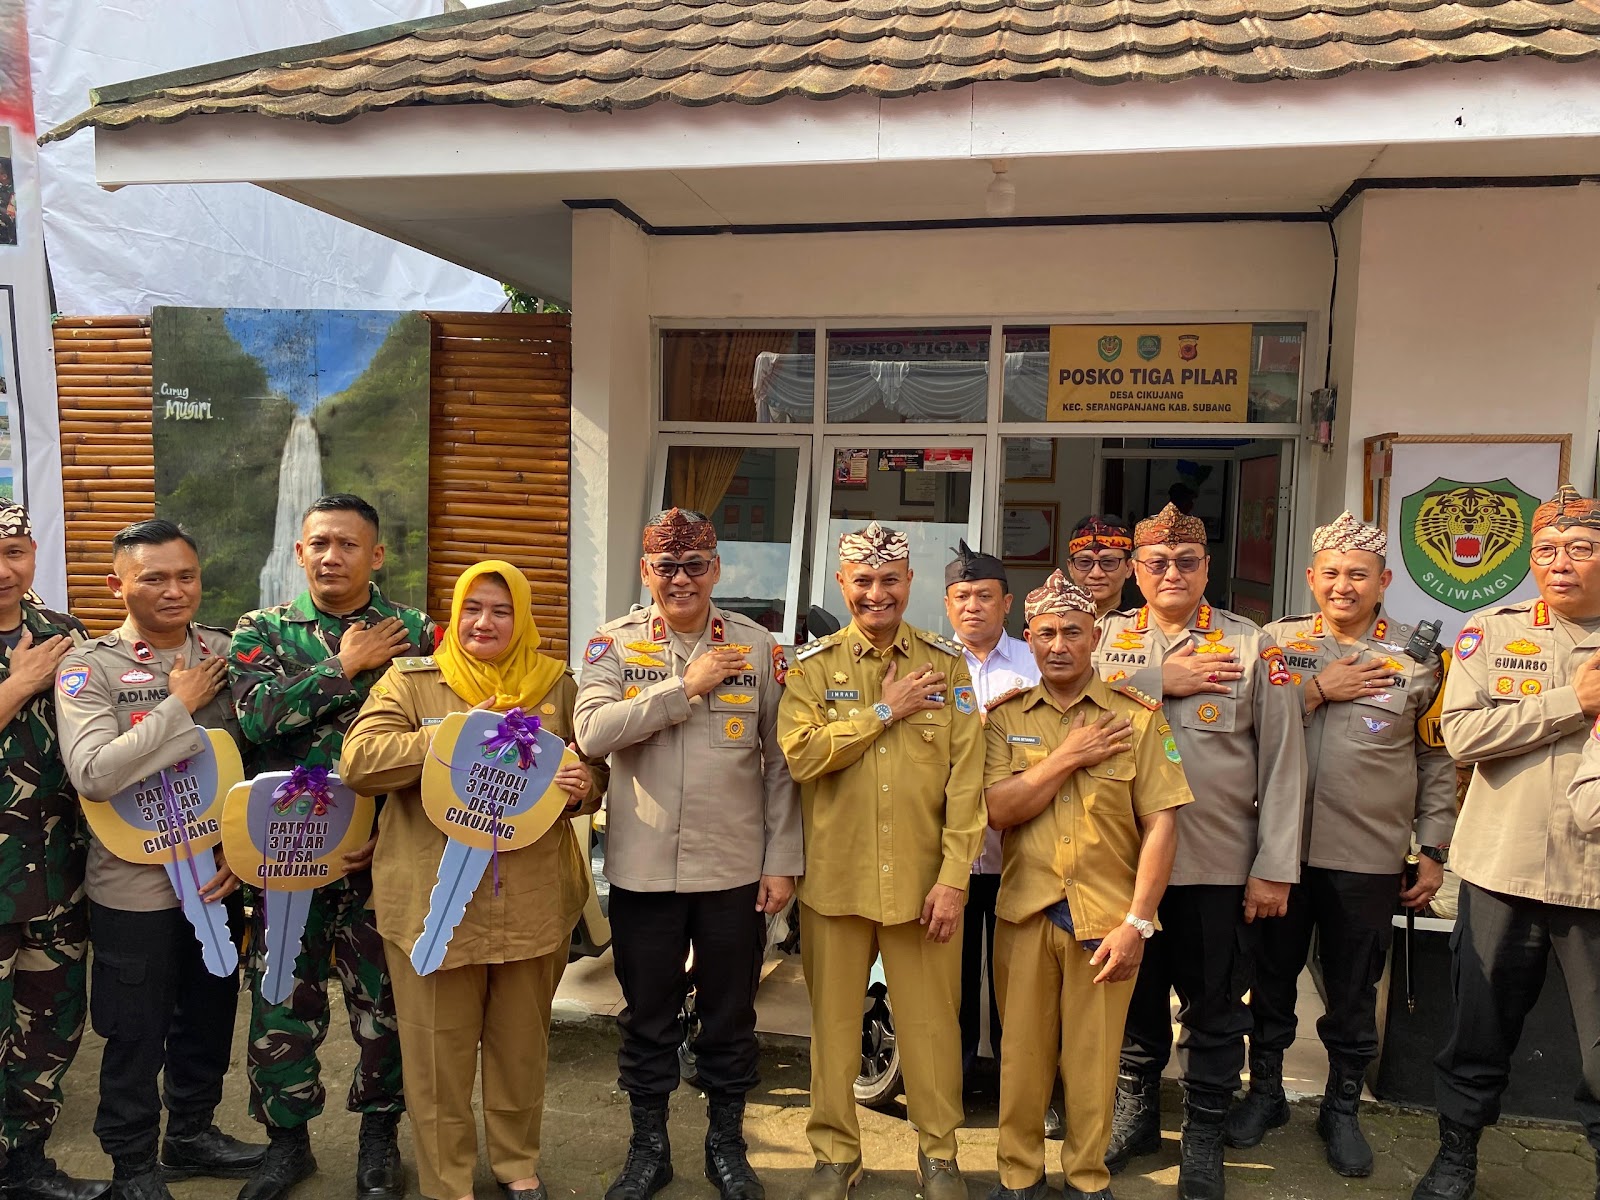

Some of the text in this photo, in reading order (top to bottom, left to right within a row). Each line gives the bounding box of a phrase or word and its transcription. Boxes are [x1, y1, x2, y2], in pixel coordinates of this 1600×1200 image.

[908, 340, 970, 355] TIGA
[1059, 368, 1238, 385] POSKO TIGA PILAR
[1109, 390, 1184, 400] DESA CIKUJANG
[1062, 402, 1232, 412] KEC. SERANGPANJANG KAB. SUBANG
[1422, 572, 1514, 600] SILIWANGI
[1105, 652, 1146, 665] TATAR
[624, 668, 668, 682] RUDY
[722, 673, 757, 687] OLRI
[469, 762, 528, 793] PATROLI
[465, 778, 520, 807] 3 PILAR
[142, 806, 154, 821] 3
[467, 796, 505, 819] DESA
[445, 807, 515, 841] CIKUJANG
[269, 836, 280, 849] 3
[257, 864, 329, 877] CIKUJANG
